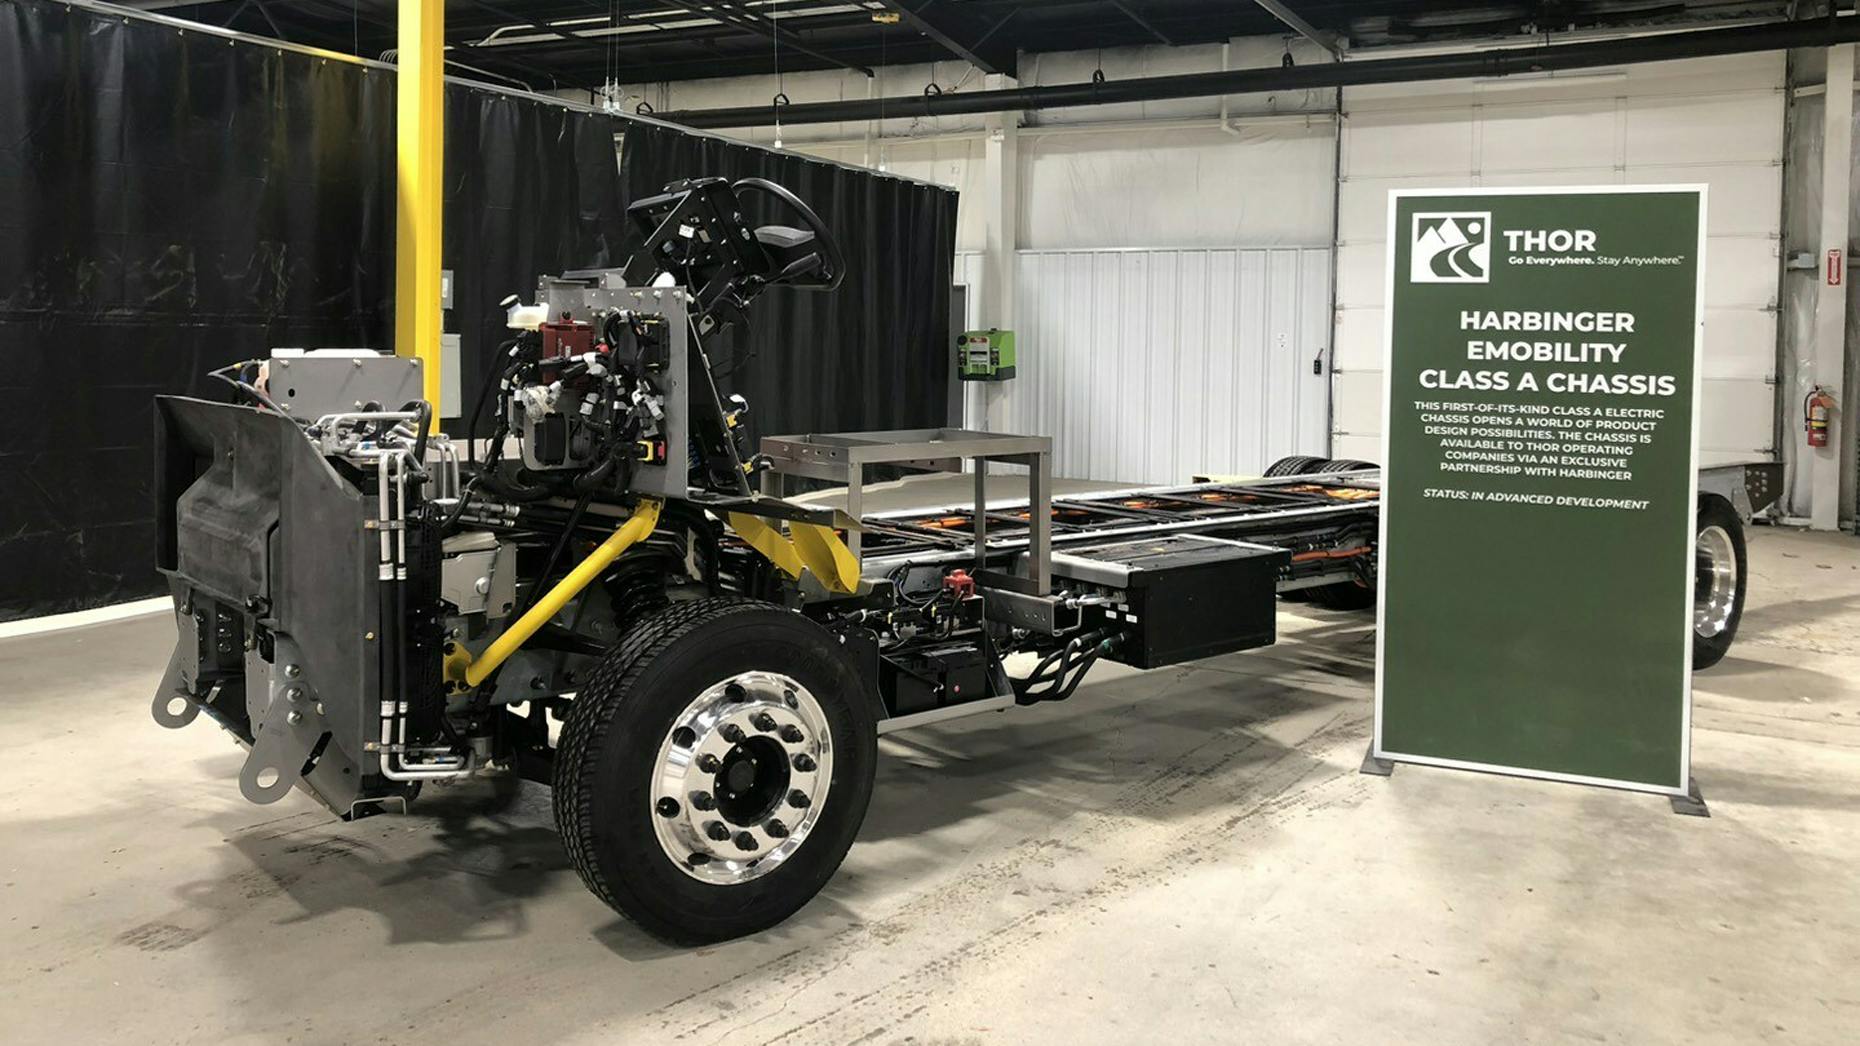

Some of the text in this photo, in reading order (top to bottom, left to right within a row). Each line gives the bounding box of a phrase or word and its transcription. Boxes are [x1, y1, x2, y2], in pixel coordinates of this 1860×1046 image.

[1503, 230, 1597, 252] THOR
[1508, 256, 1524, 265] Go
[1526, 255, 1595, 267] Everywhere.
[1597, 256, 1621, 267] Stay
[1461, 311, 1634, 332] HARBINGER
[1468, 341, 1626, 363] EMOBILITY
[1419, 369, 1675, 396] CLASS A CHASSIS
[1414, 401, 1665, 419] THIS FIRST-OF-ITS-KIND CLASS A ELECTRIC
[1420, 413, 1657, 431] CHASSIS OPENS A WORLD OF PRODUCT
[1424, 425, 1652, 444] DESIGN POSSIBILITIES. THE CHASSIS IS
[1440, 438, 1633, 455] AVAILABLE TO THOR OPERATING
[1445, 450, 1627, 468] COMPANIES VIA AN EXCLUSIVE
[1440, 462, 1632, 481] PARTNERSHIP WITH HARBINGER
[1423, 488, 1649, 510] STATUS: IN ADVANCED DEVELOPMENT
